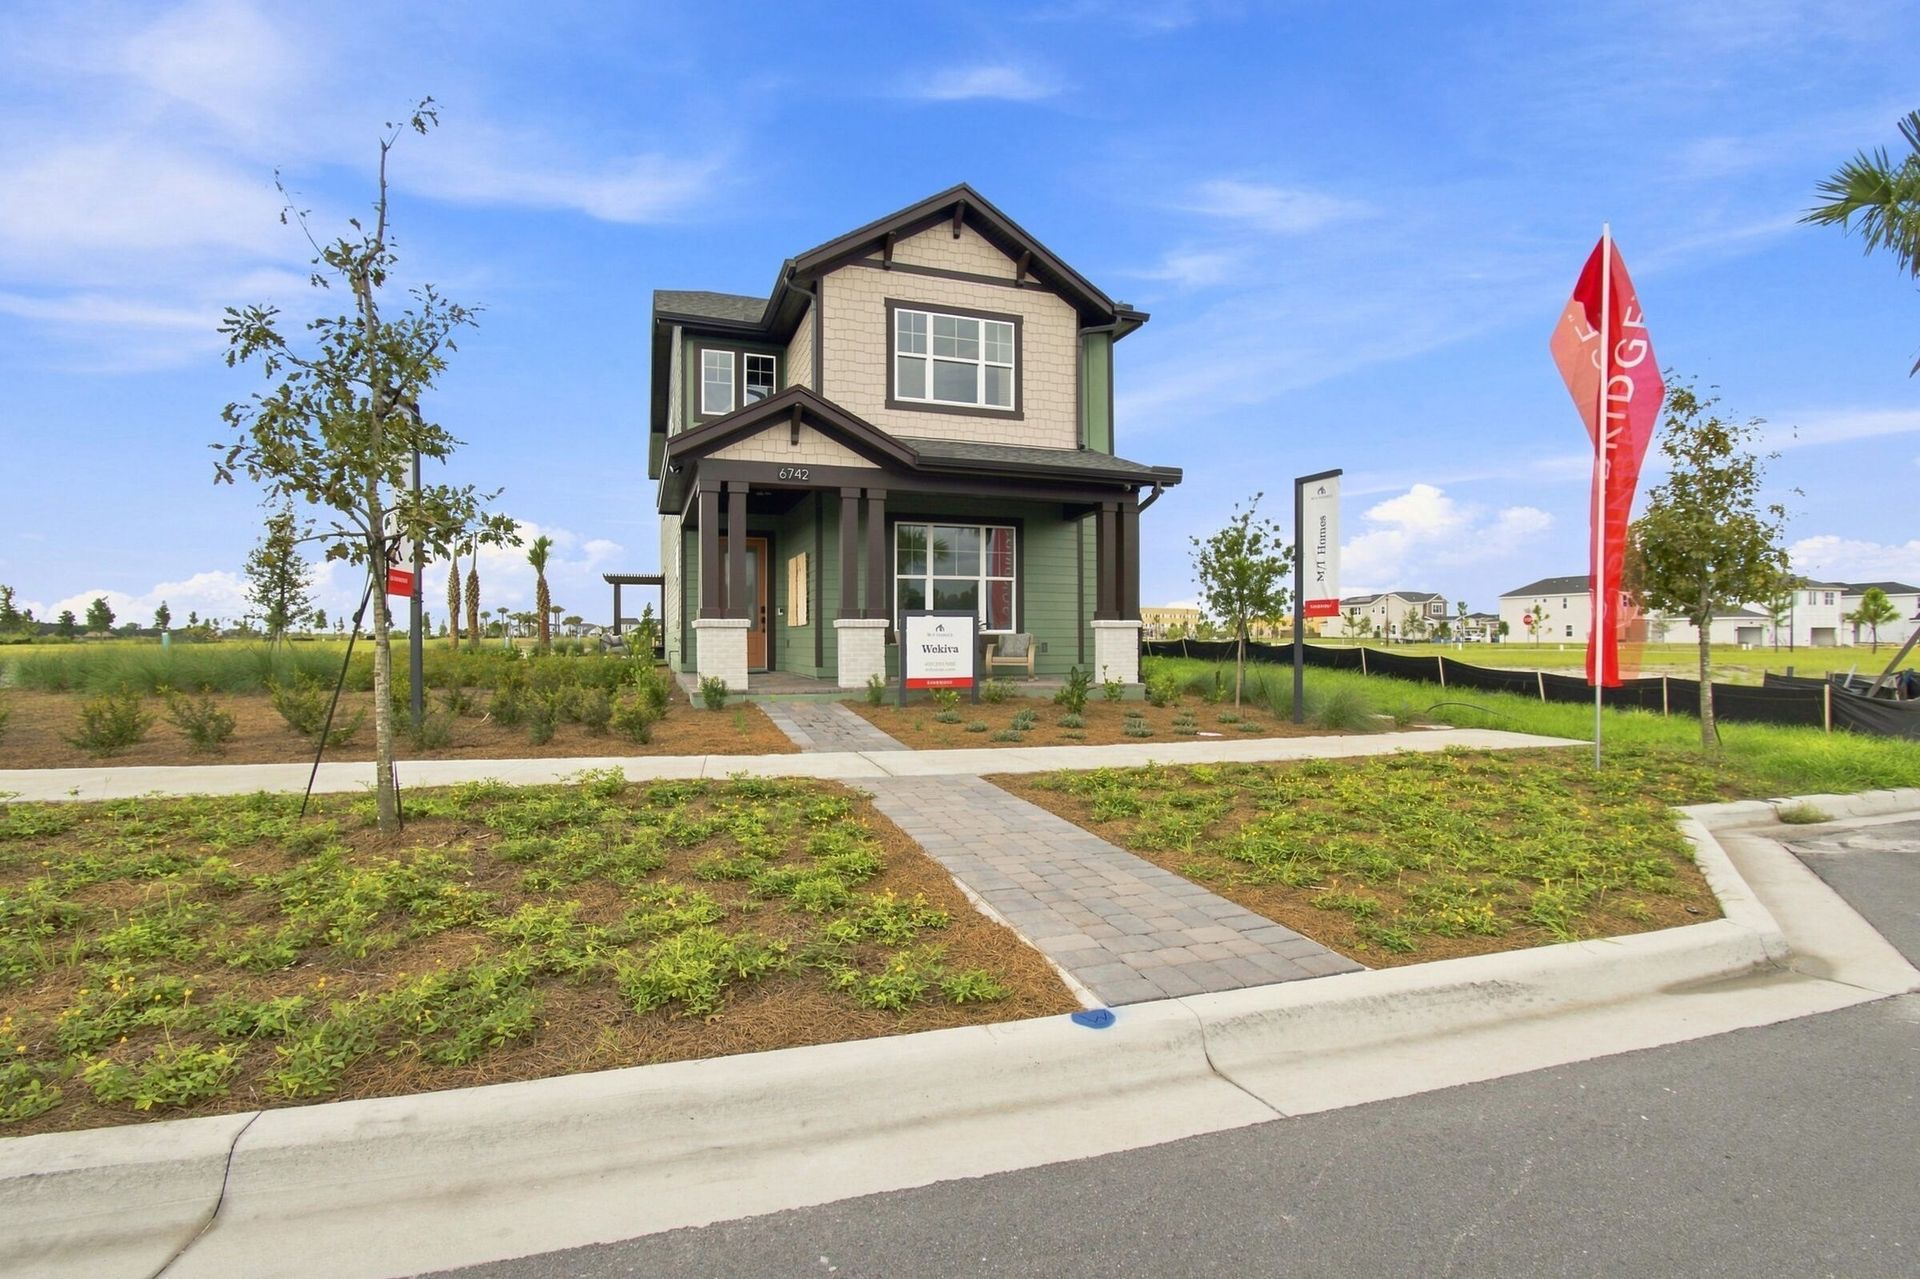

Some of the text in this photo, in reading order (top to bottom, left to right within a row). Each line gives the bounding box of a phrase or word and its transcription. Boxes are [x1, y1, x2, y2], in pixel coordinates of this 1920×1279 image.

[779, 467, 809, 480] 6742
[1317, 515, 1327, 555] Homes
[921, 644, 959, 654] Wekiva
